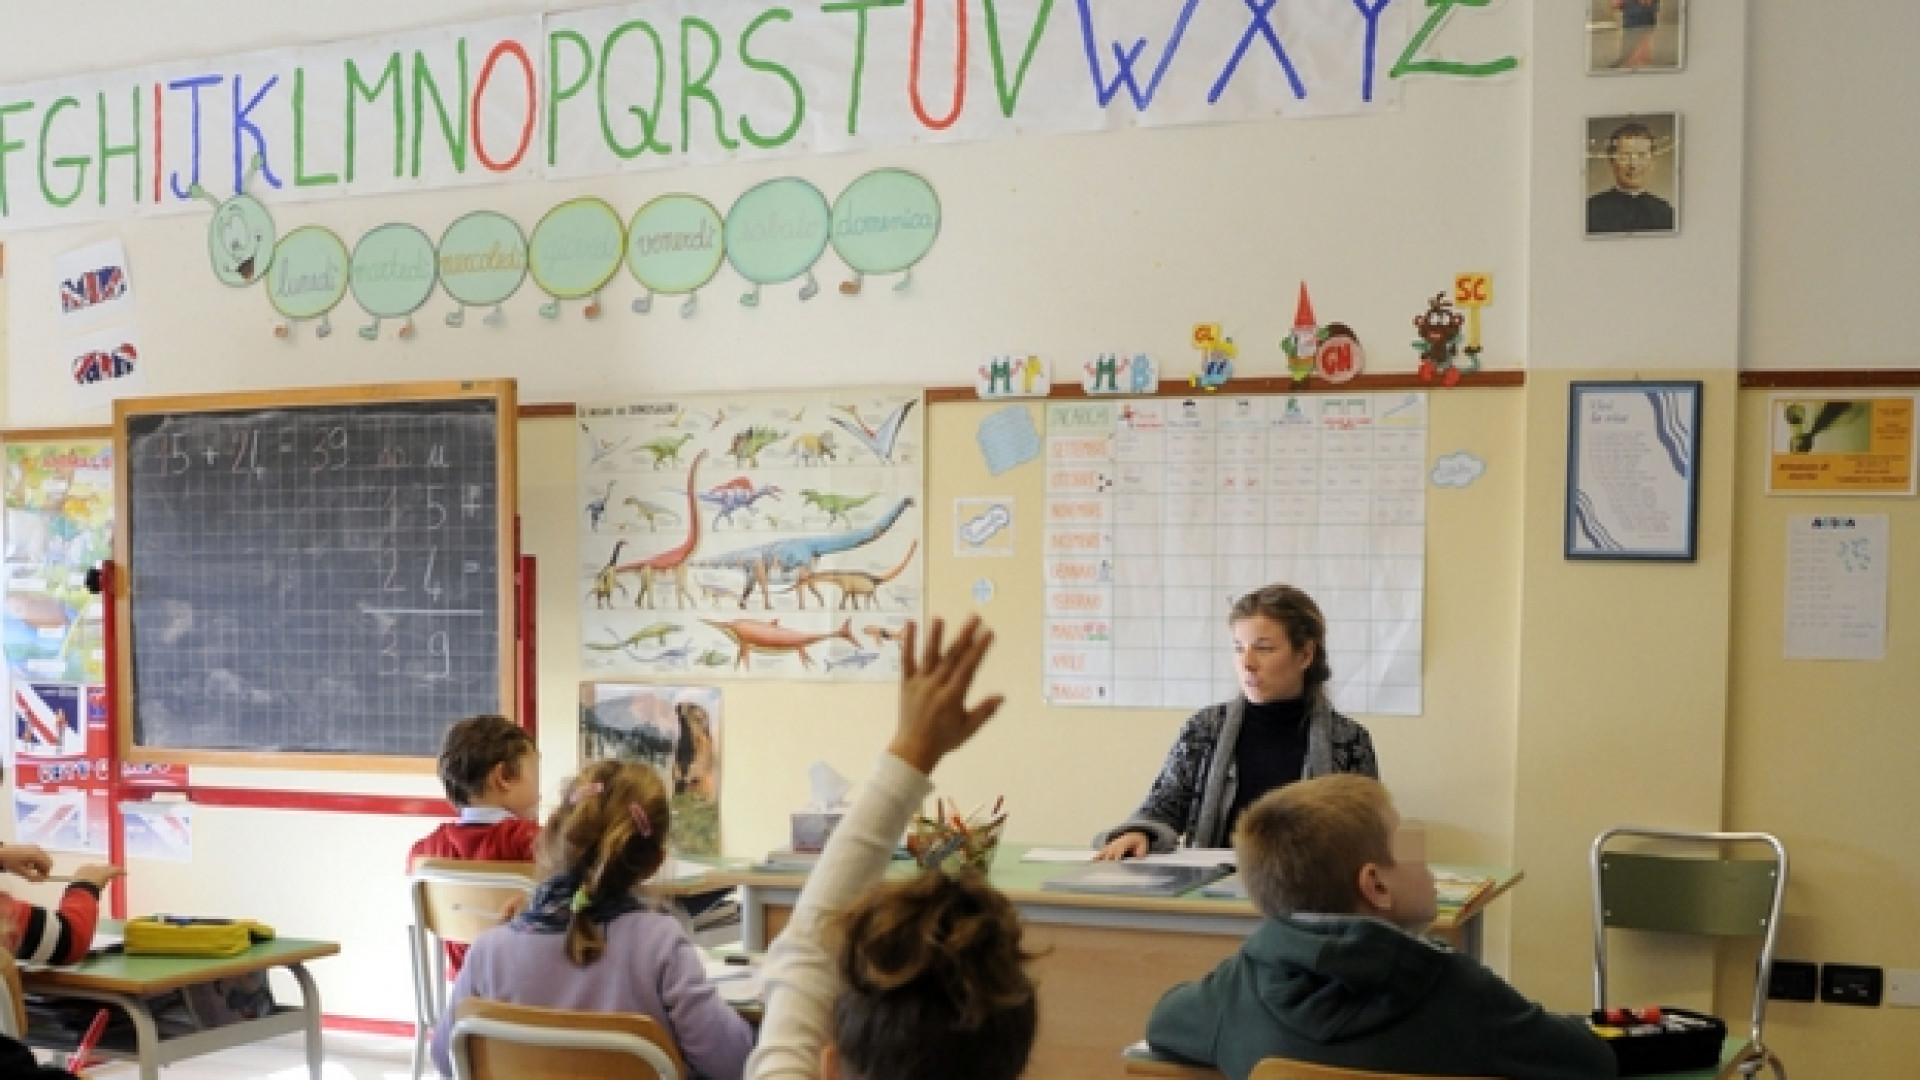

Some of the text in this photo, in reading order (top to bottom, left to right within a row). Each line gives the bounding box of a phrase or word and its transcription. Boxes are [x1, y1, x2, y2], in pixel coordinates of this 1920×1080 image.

[836, 202, 934, 237] domenica
[1455, 277, 1488, 301] SC
[1321, 343, 1355, 375] GN
[157, 432, 190, 476] 15
[311, 426, 348, 473] 39
